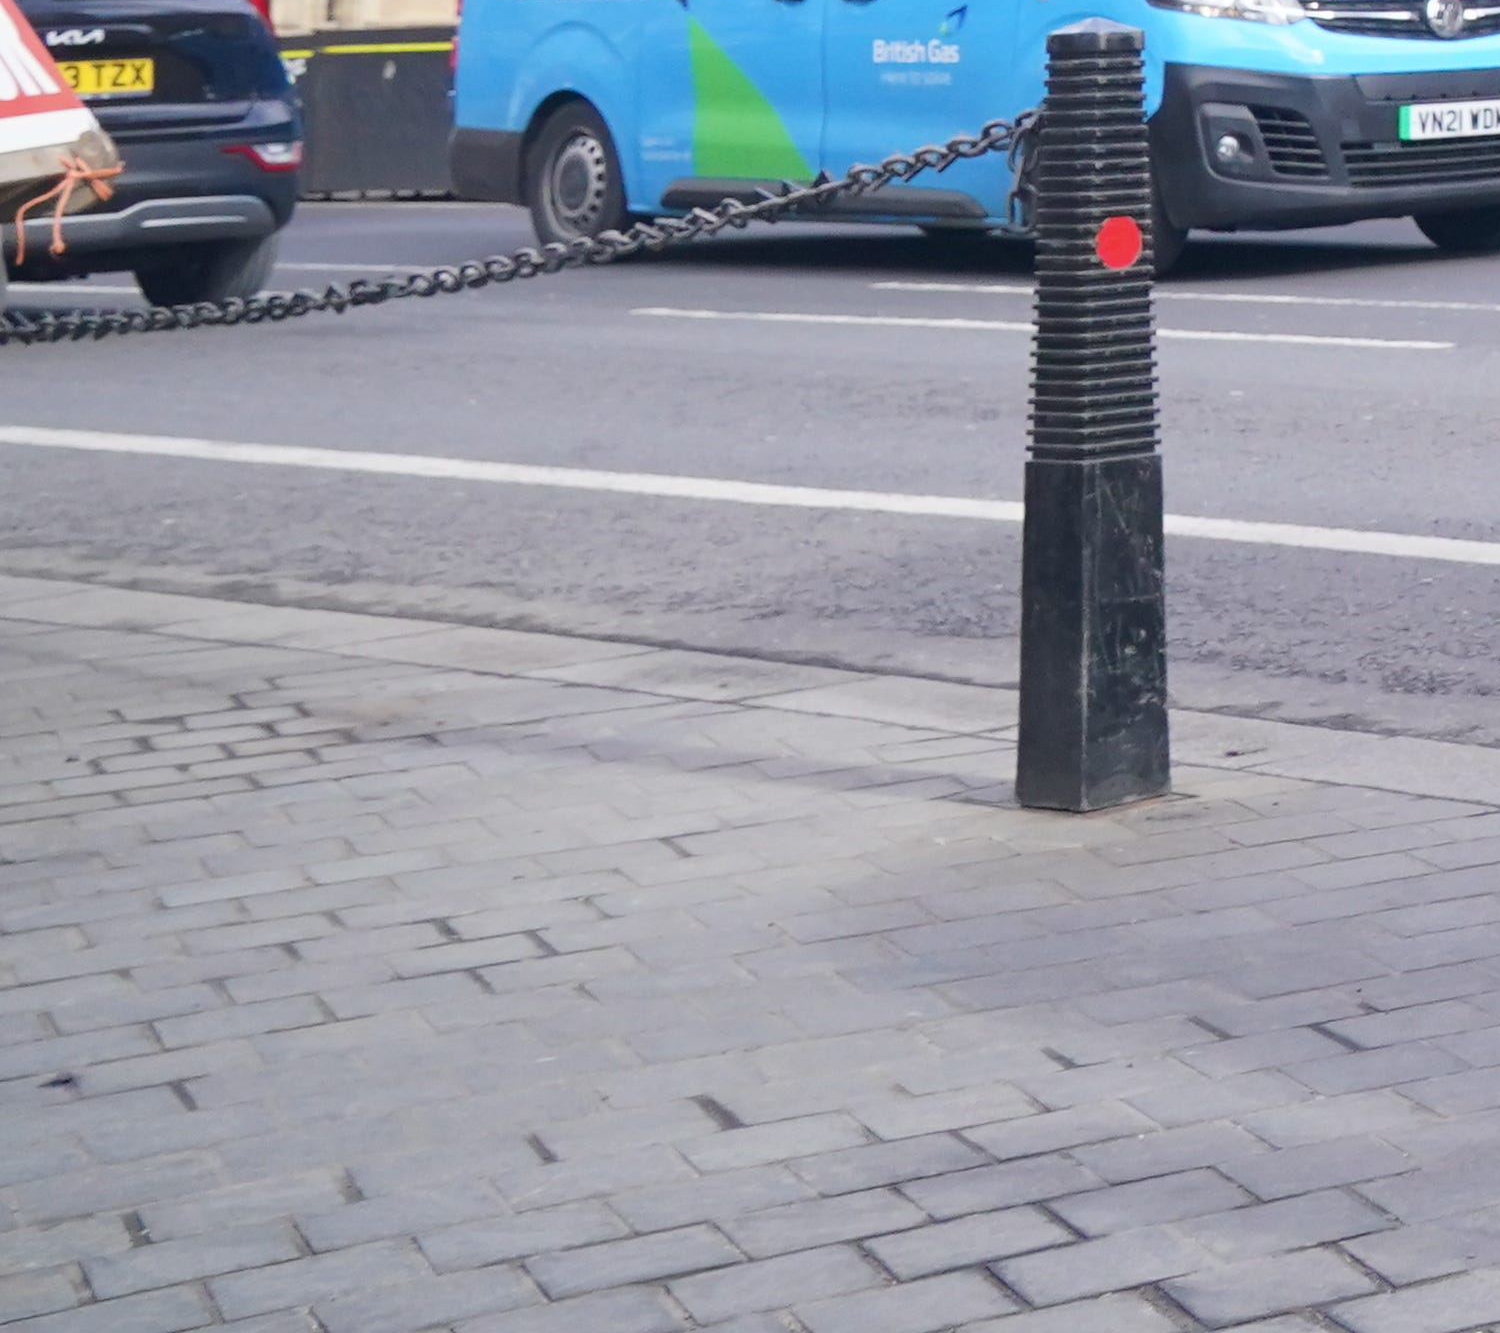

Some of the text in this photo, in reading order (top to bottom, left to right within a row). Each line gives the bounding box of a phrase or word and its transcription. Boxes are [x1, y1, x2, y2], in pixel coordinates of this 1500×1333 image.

[873, 38, 960, 63] British Gas
[92, 64, 145, 88] TZX
